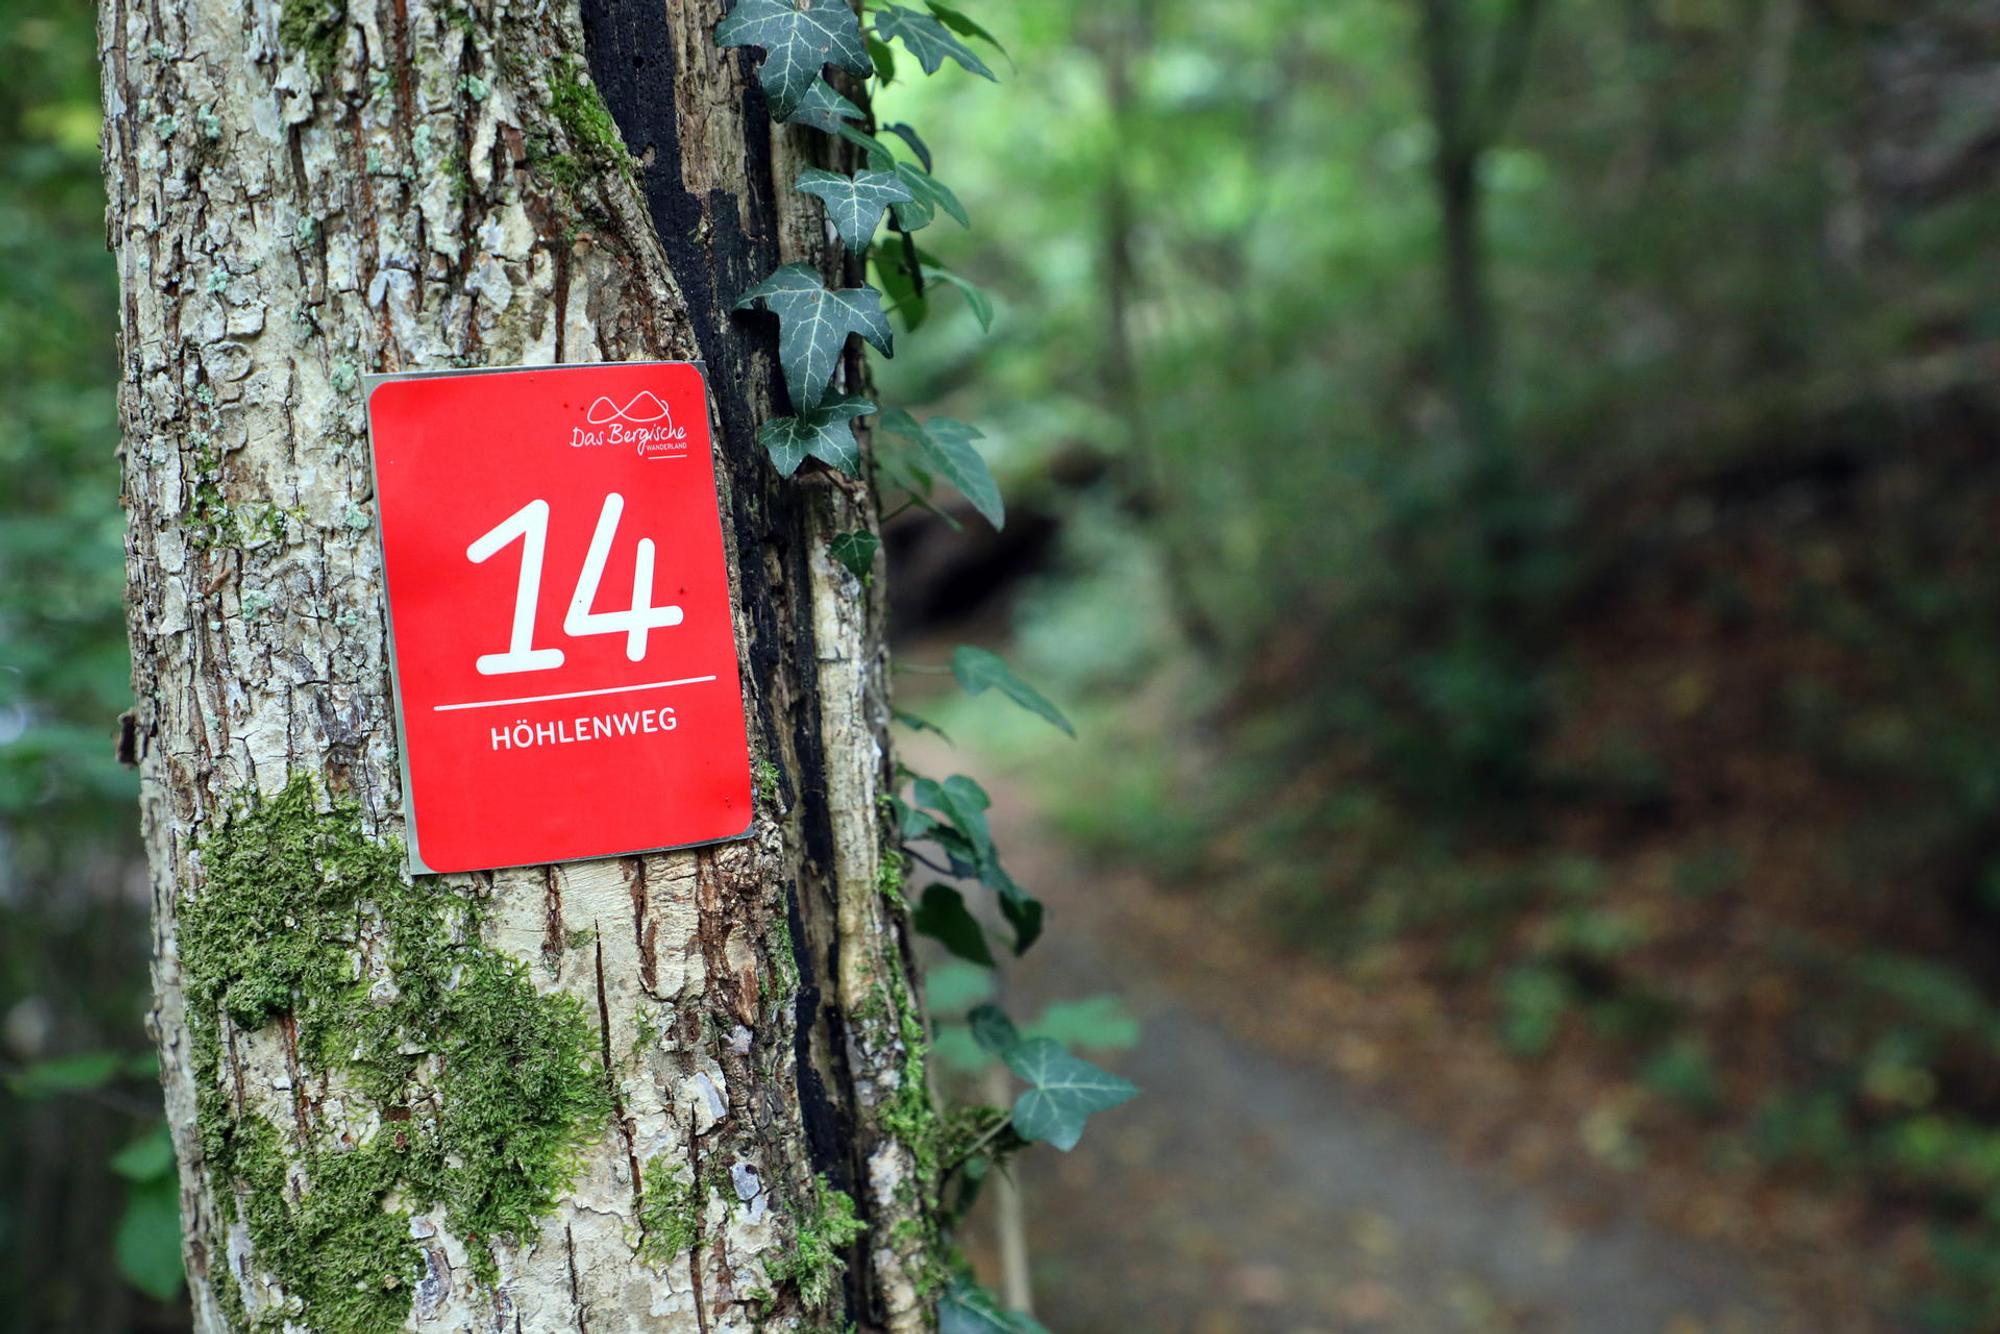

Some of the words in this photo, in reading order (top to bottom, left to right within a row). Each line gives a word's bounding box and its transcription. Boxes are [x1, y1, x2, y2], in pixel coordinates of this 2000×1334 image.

[569, 426, 604, 448] Das
[606, 422, 688, 456] Bergische
[647, 442, 688, 451] WANDERLAND
[466, 491, 685, 676] 14
[490, 706, 678, 751] HÖHLENWEG
